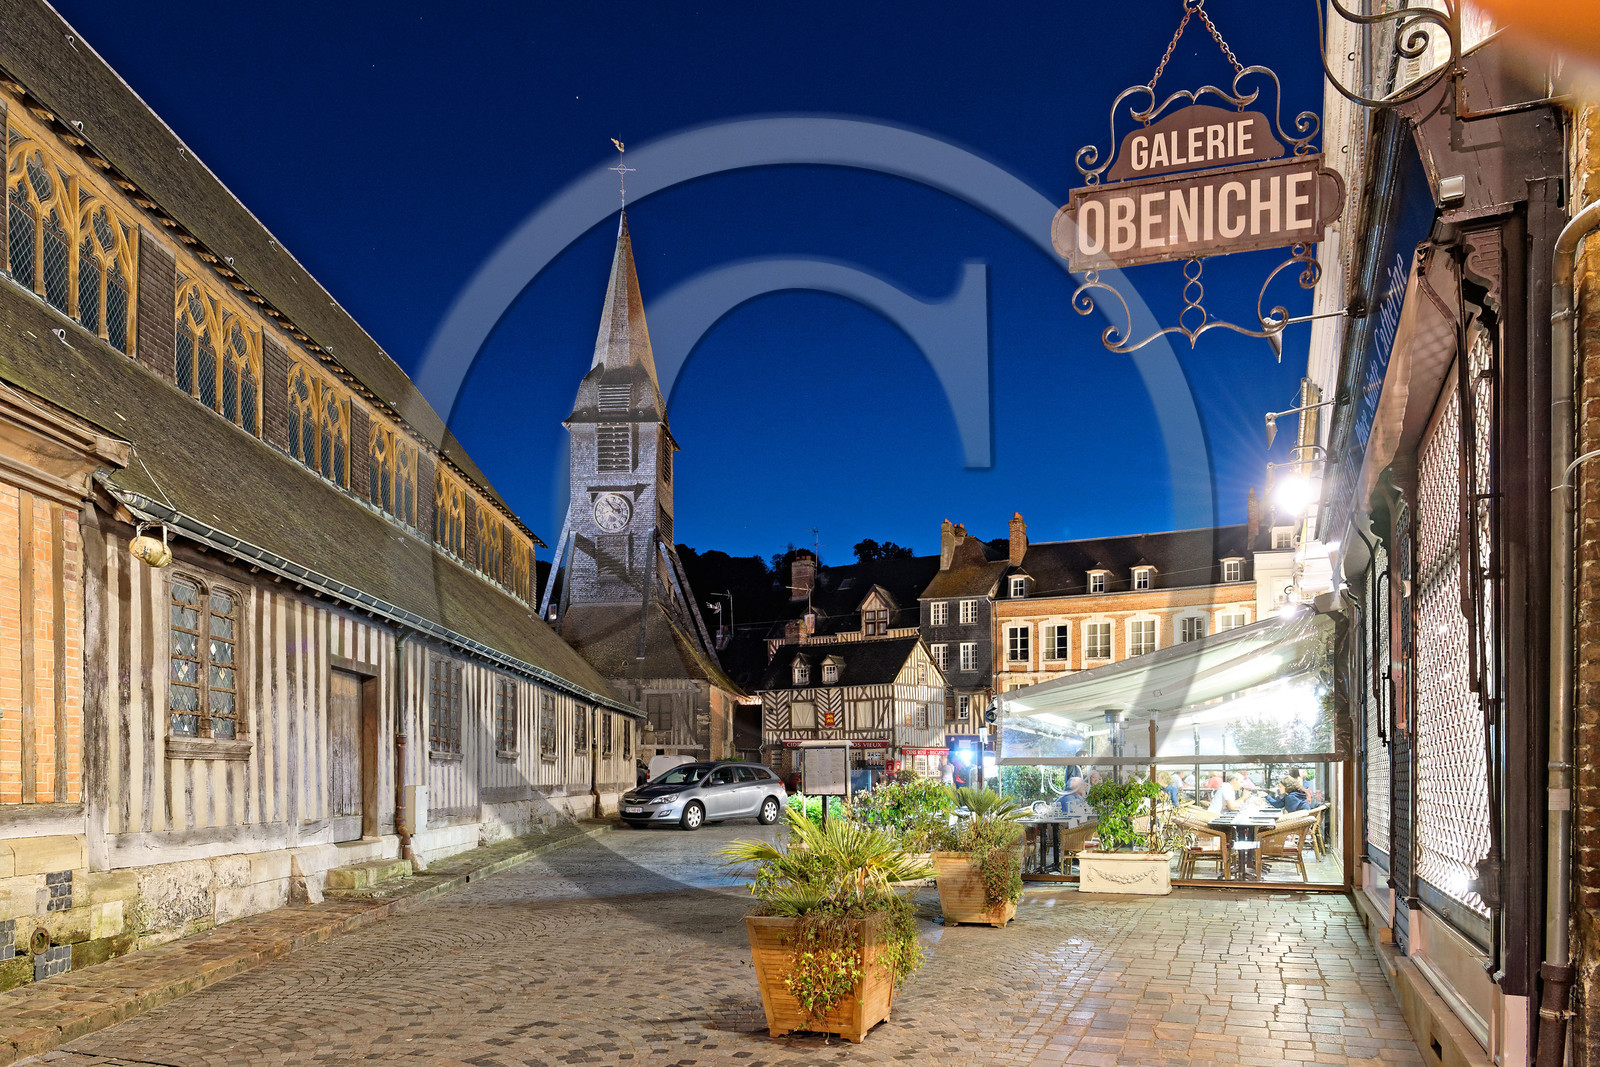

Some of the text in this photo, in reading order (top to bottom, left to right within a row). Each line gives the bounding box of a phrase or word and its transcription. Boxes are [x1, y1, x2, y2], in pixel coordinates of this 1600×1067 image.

[1130, 118, 1255, 171] GALERIE
[1077, 171, 1313, 257] OBENICHE
[1373, 252, 1409, 367] Catherine
[863, 741, 882, 749] VIEUX
